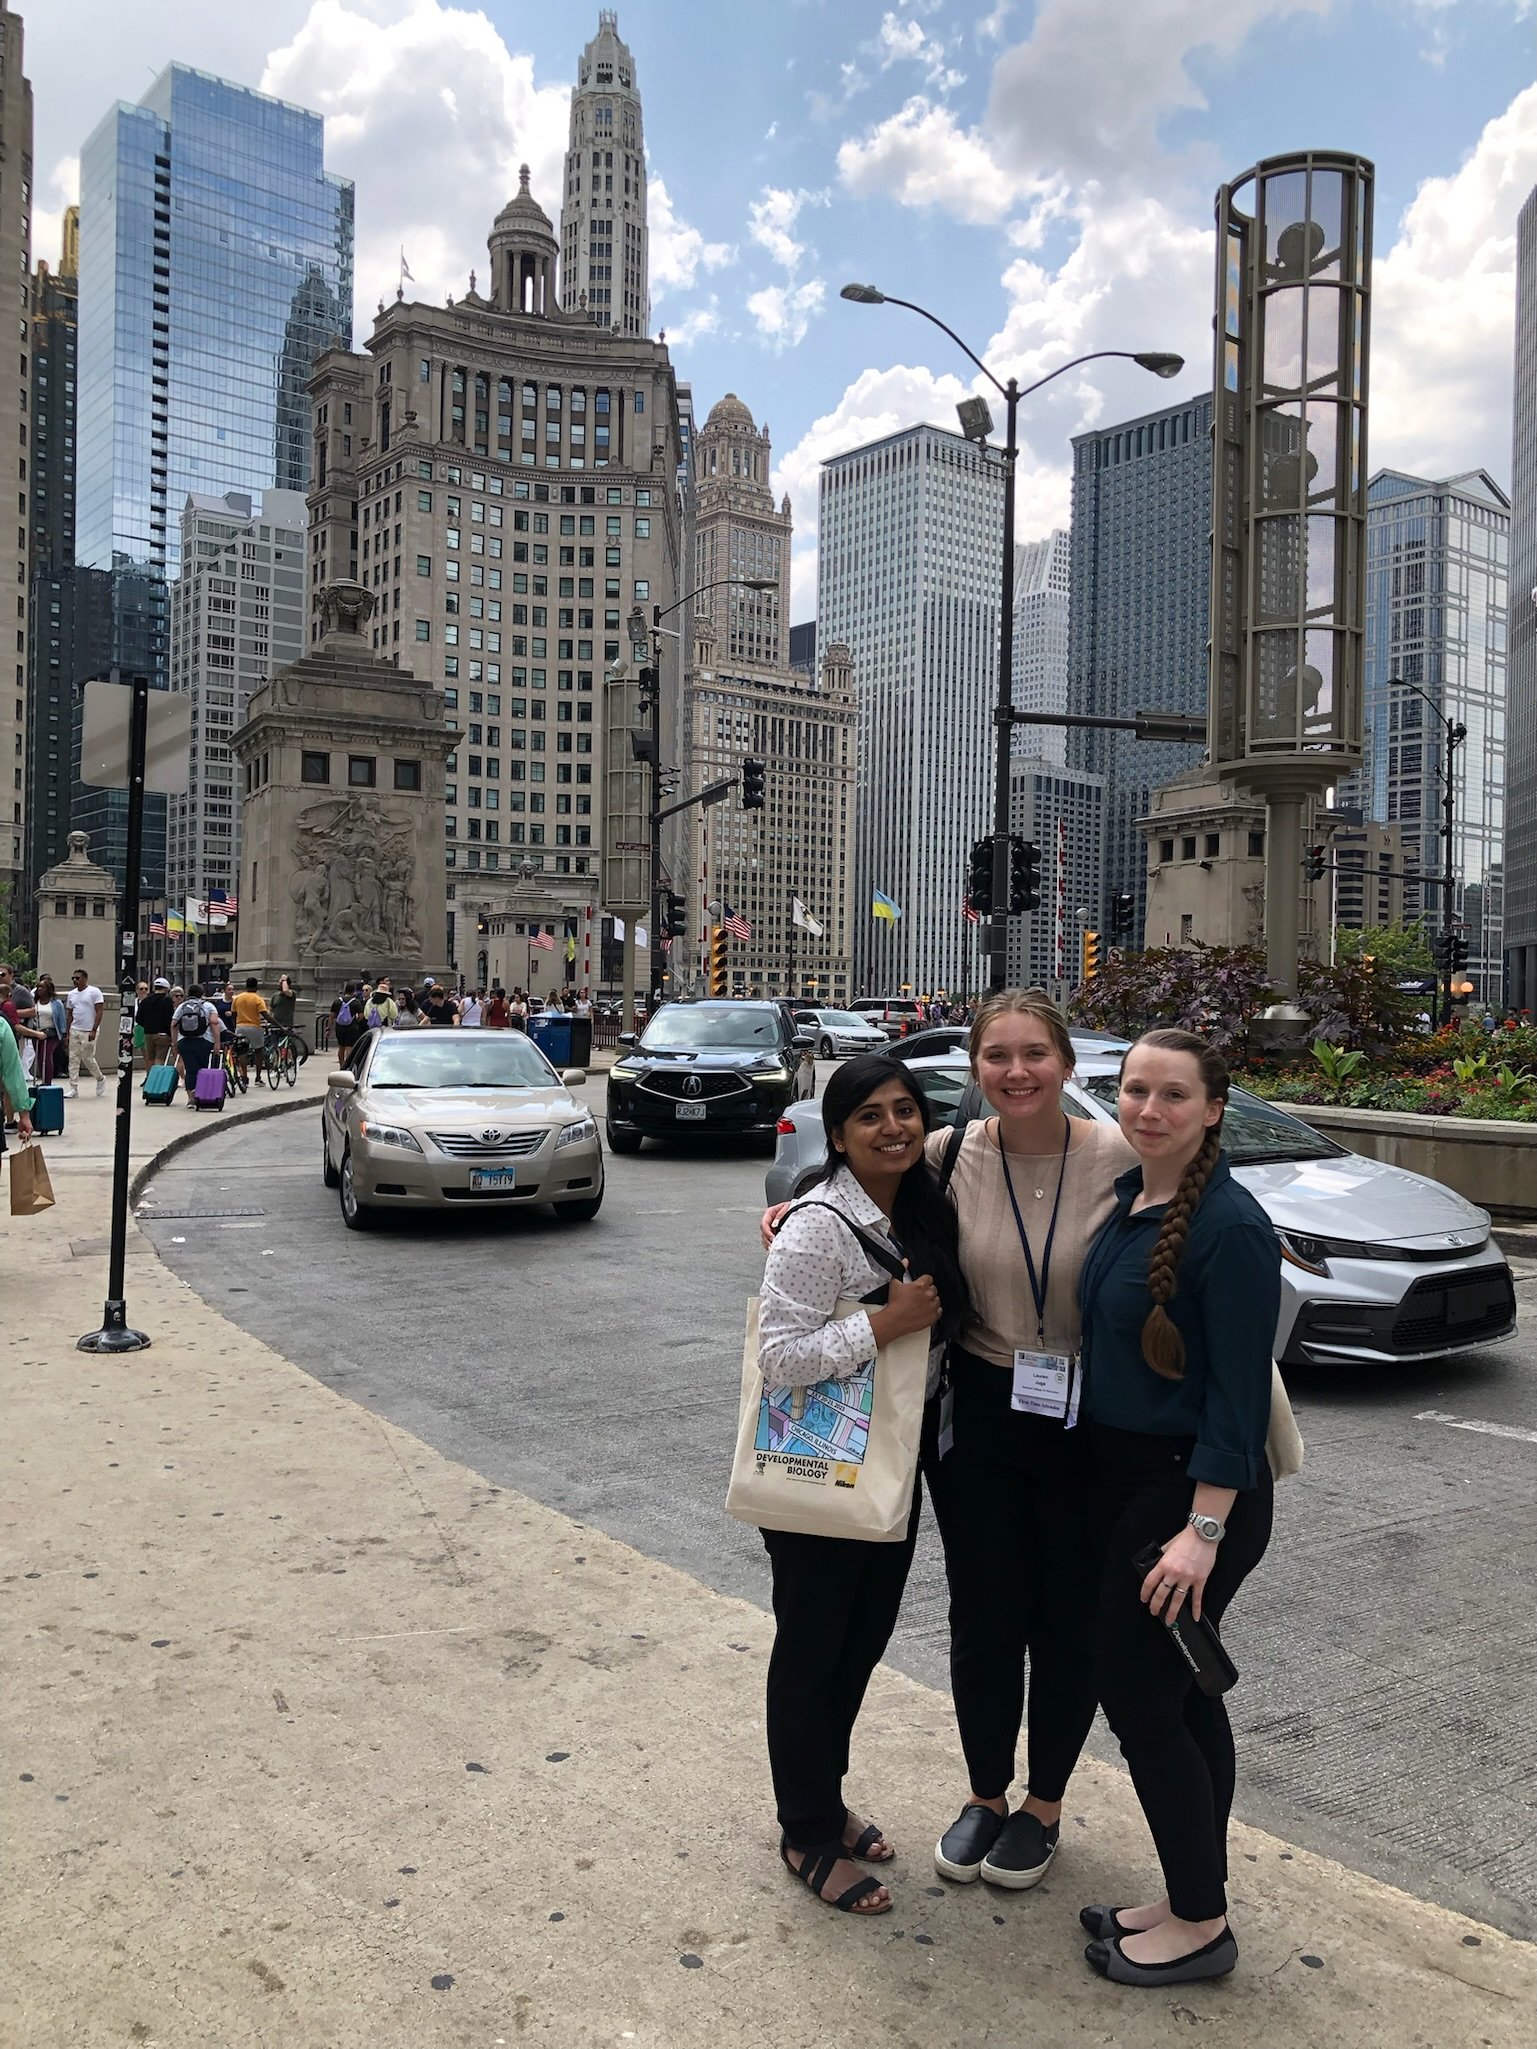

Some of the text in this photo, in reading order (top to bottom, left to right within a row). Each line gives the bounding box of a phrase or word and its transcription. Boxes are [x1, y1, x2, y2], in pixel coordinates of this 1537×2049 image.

[790, 1425, 813, 1443] CHICAGO,
[814, 1438, 838, 1455] ILLINOIS
[756, 1453, 829, 1471] DEVELOPMENTAL
[787, 1466, 828, 1480] BIOLOGY
[835, 1479, 855, 1489] Nikon
[1172, 1630, 1201, 1673] Development
